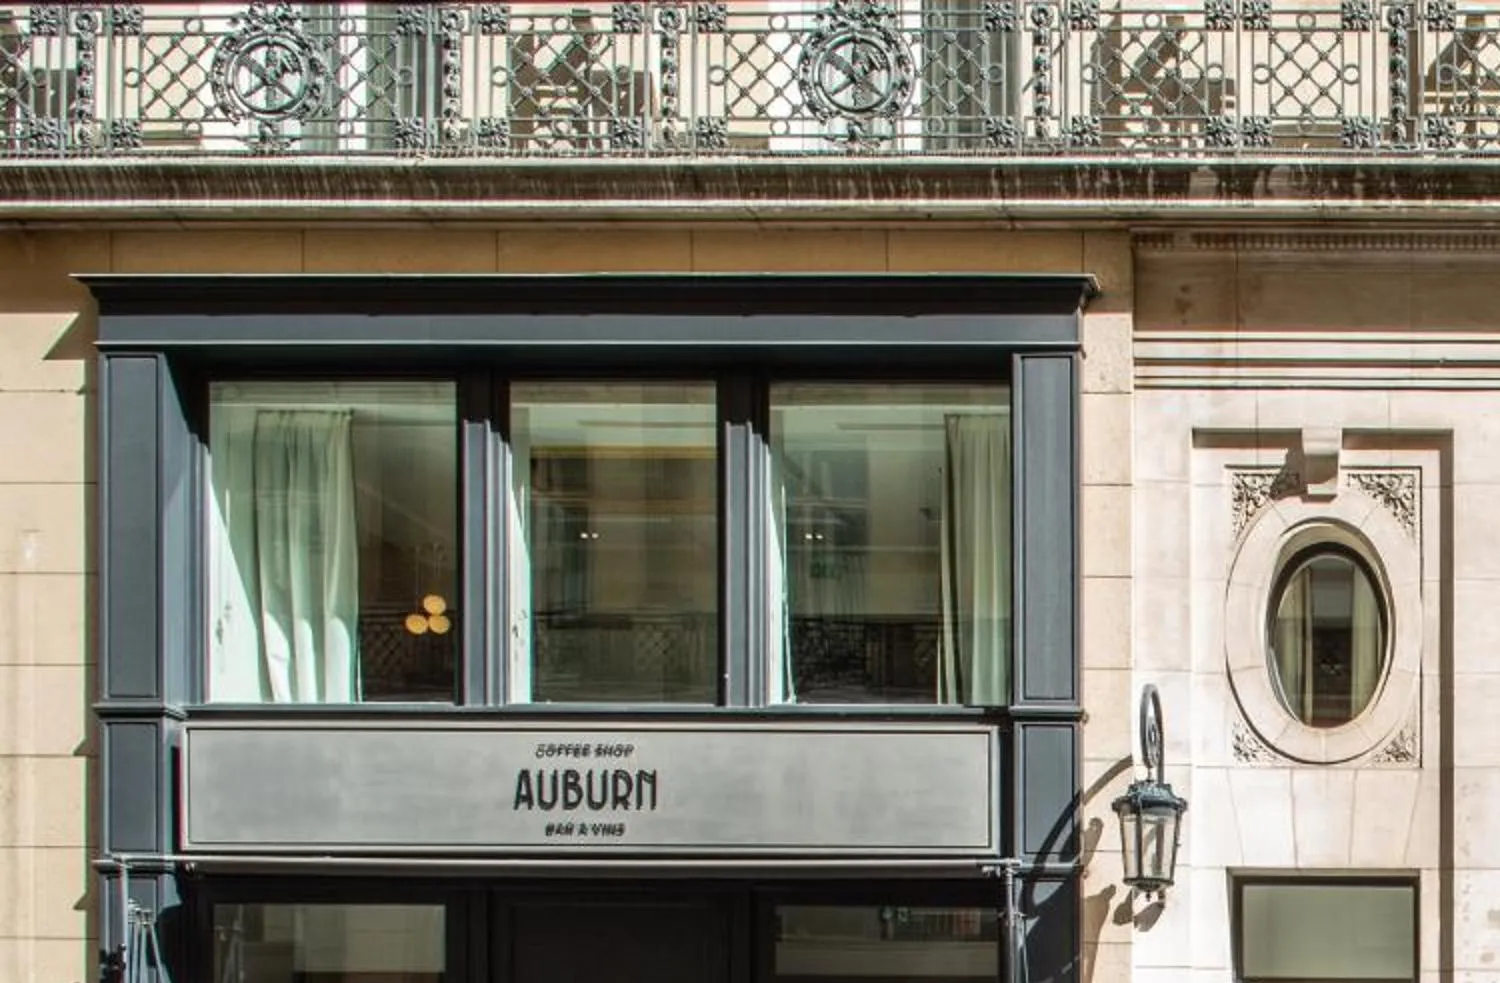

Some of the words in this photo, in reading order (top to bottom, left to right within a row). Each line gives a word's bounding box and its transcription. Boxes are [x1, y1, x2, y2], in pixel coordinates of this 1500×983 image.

[536, 744, 591, 759] COFFEE
[595, 744, 634, 757] SHOP
[513, 768, 657, 811] AUBURN
[545, 822, 574, 836] BAR
[591, 823, 625, 836] VINS
